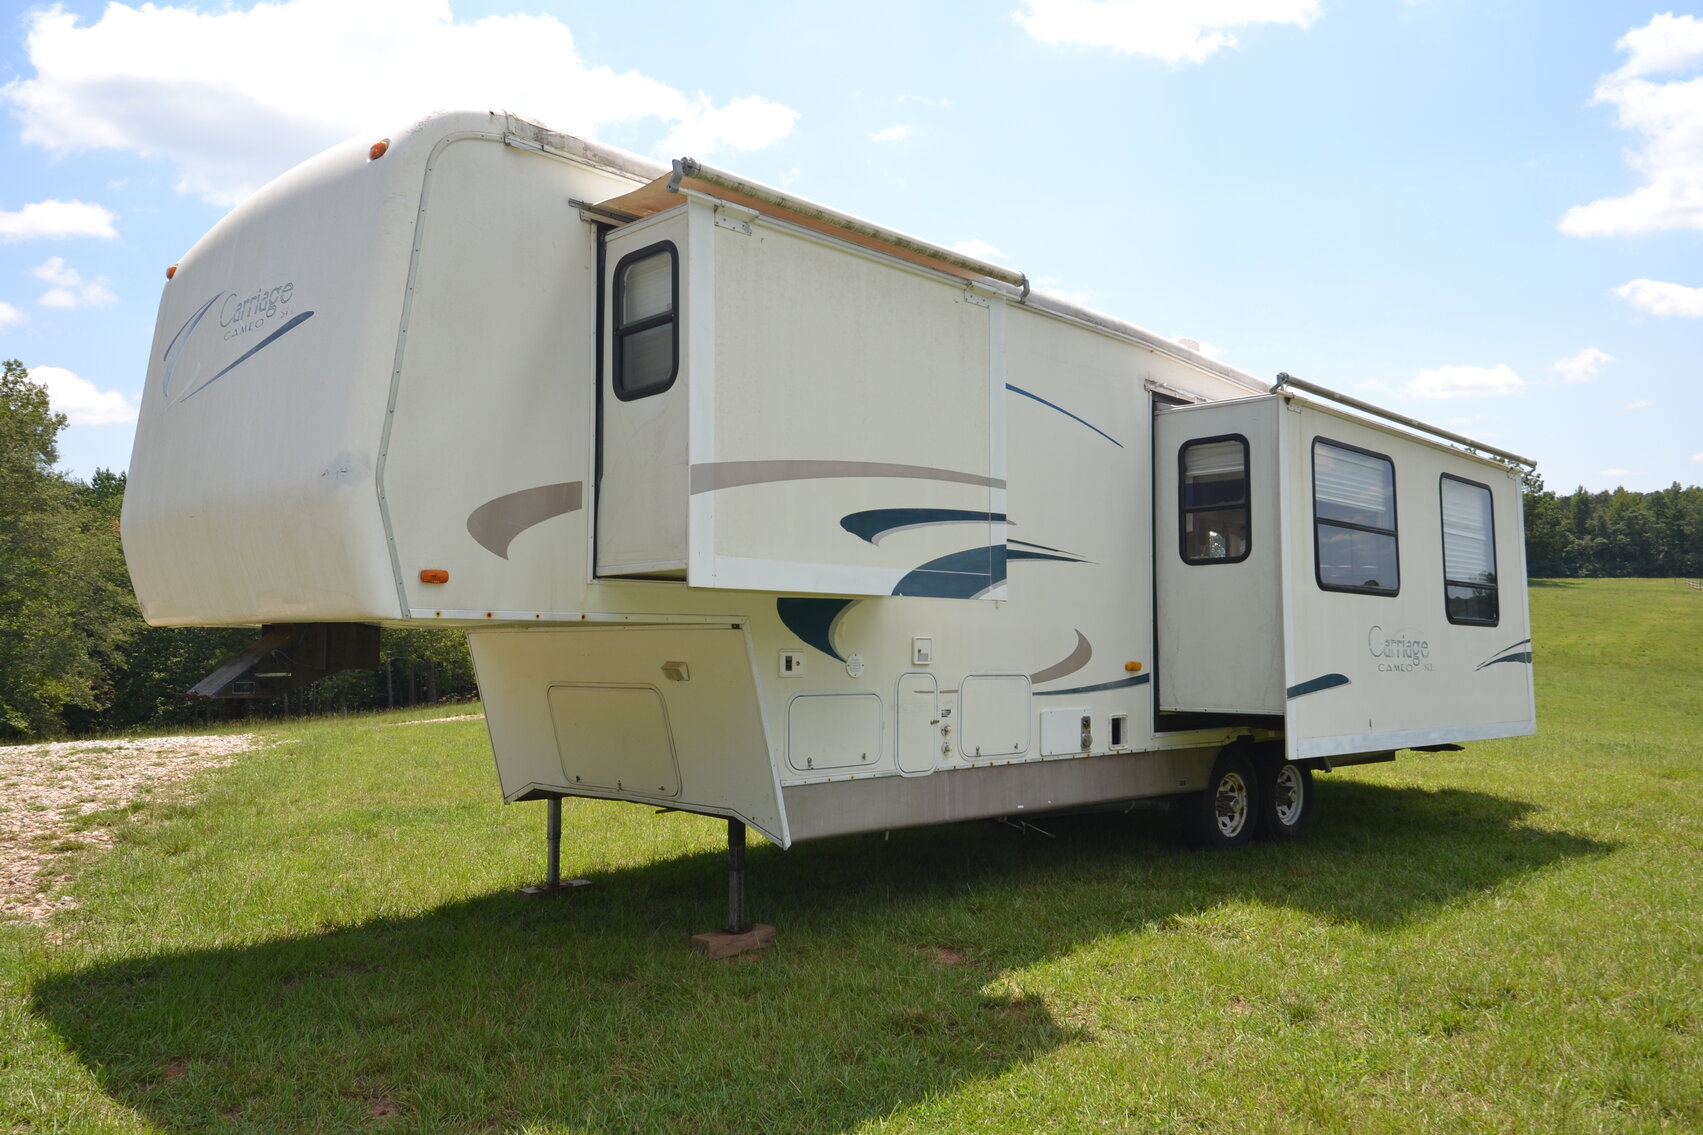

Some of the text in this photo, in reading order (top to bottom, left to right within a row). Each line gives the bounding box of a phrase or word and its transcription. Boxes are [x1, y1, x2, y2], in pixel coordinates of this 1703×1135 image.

[219, 282, 294, 328] Carriage
[223, 318, 265, 341] CAMEO
[1368, 625, 1429, 666] Carriage
[1378, 663, 1413, 672] CAMEO
